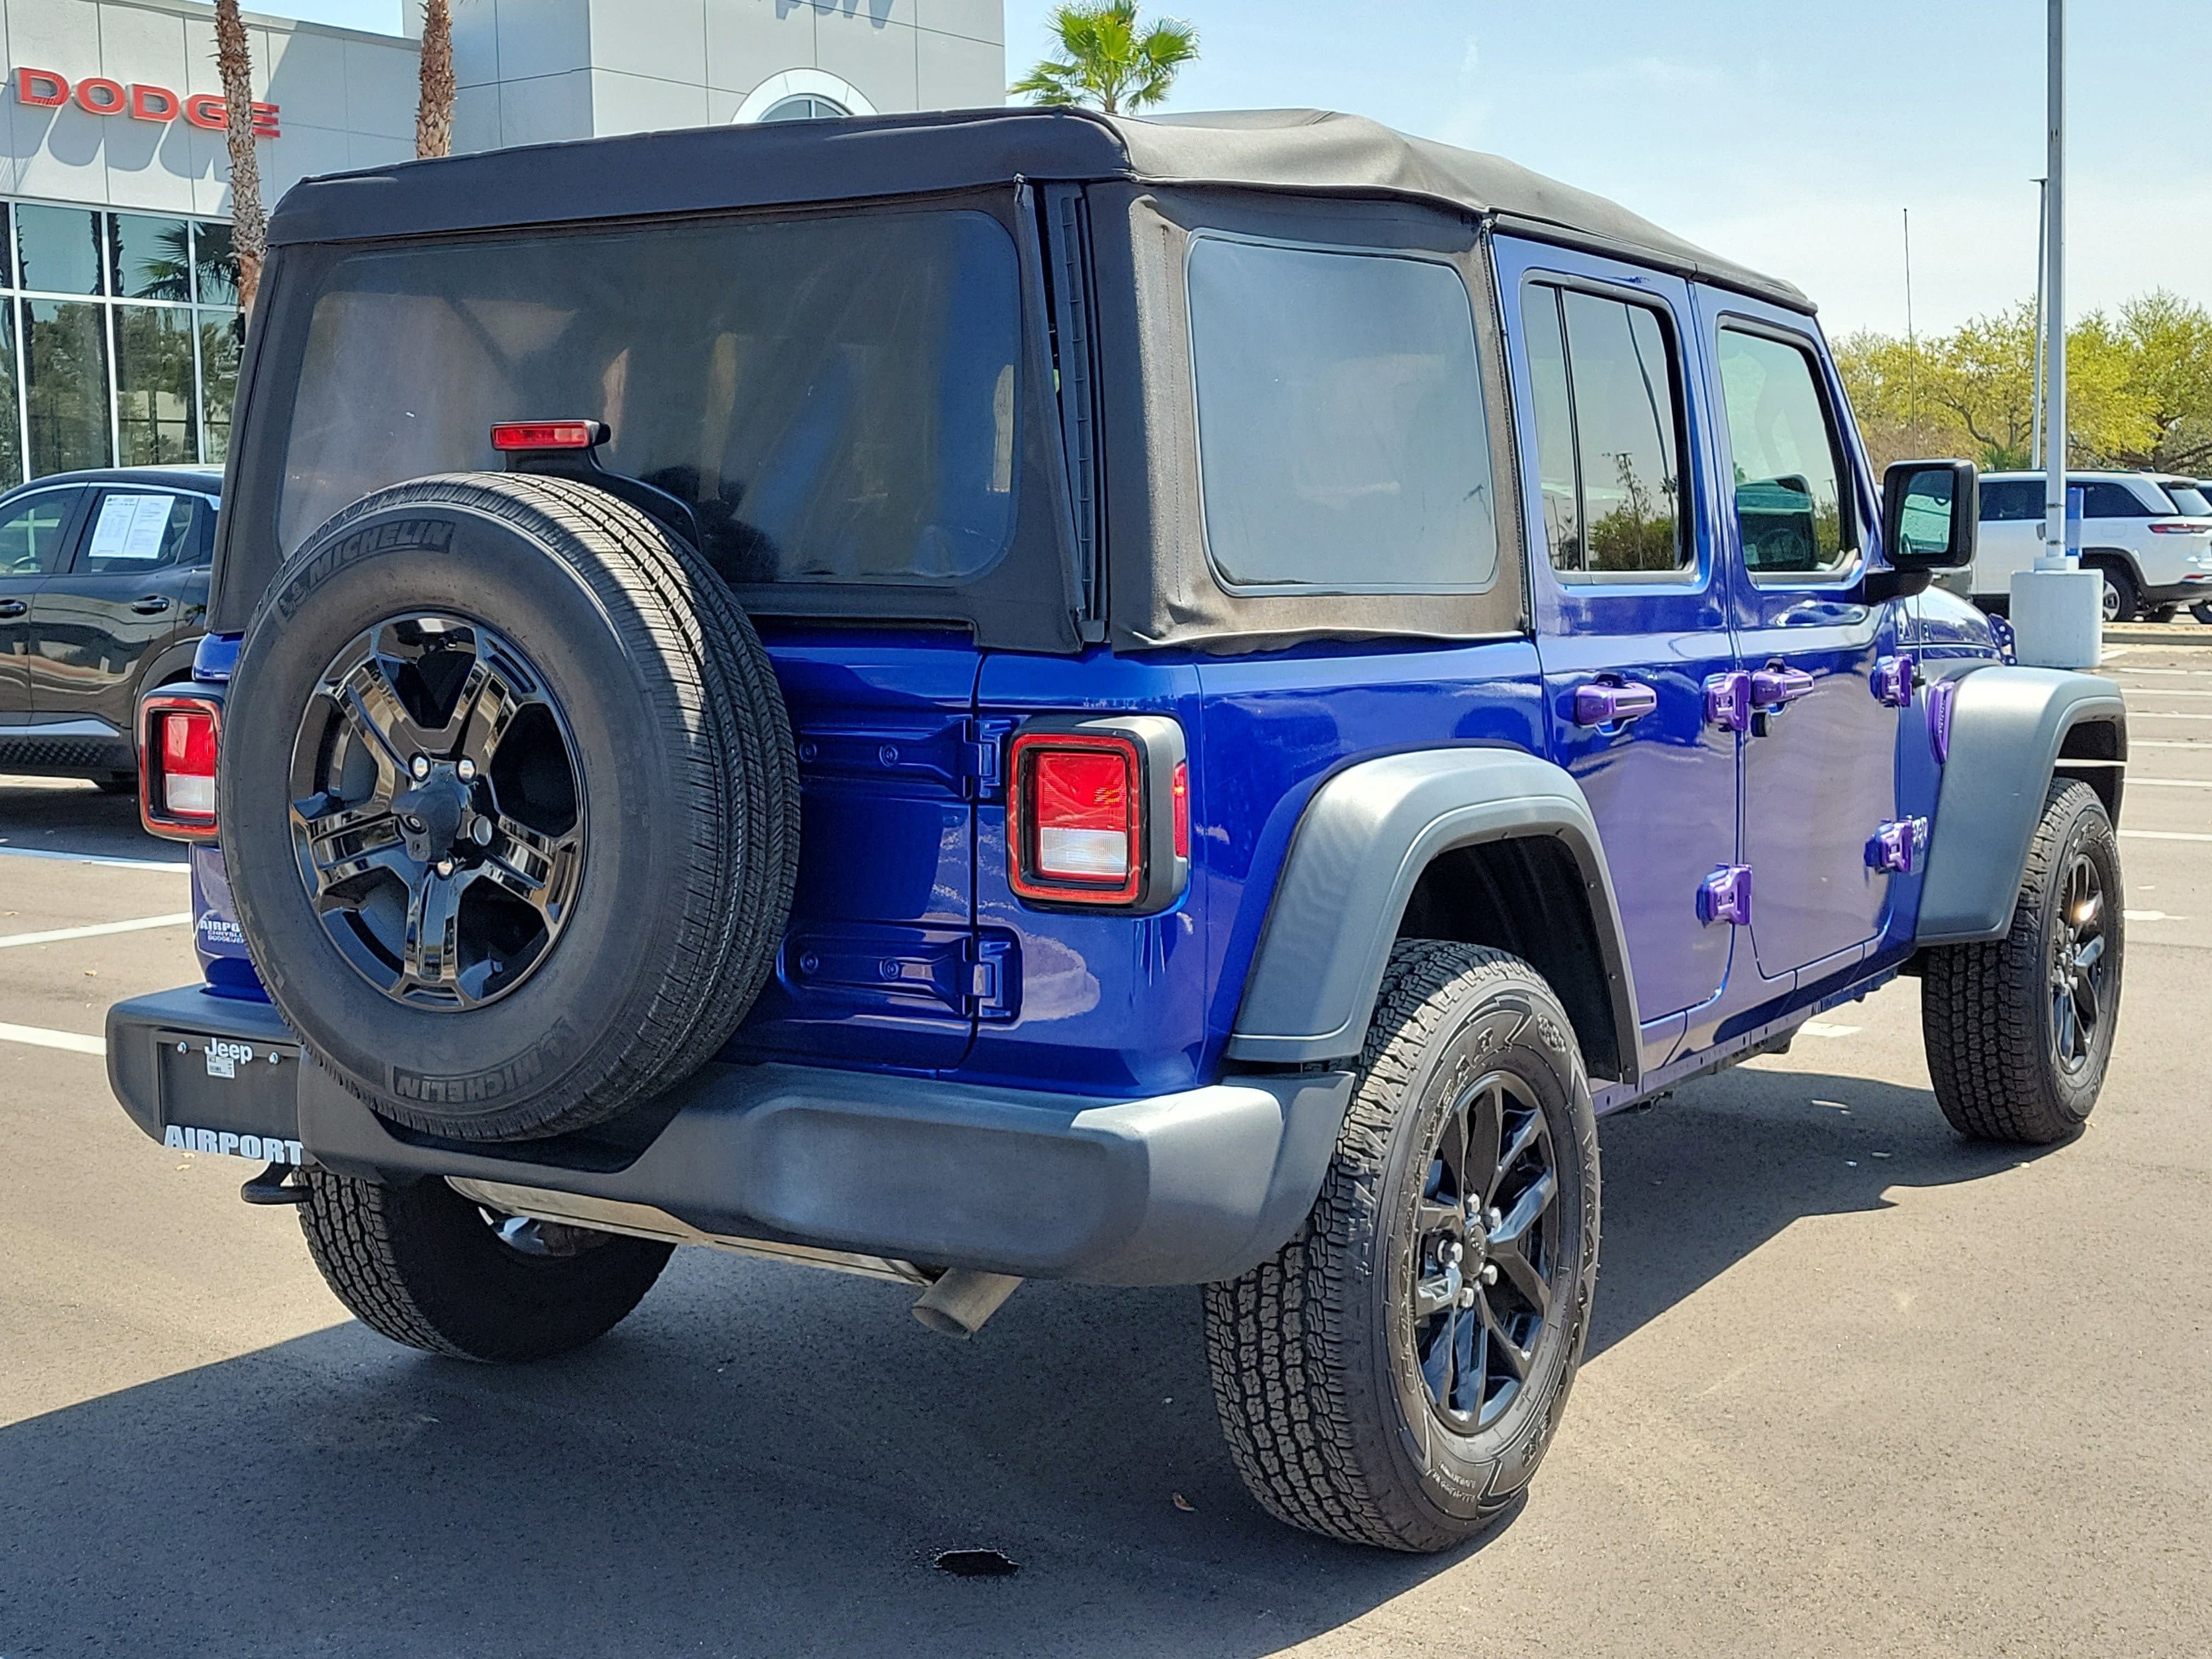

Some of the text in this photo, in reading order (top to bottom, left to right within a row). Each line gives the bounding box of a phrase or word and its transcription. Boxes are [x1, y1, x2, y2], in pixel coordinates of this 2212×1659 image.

[13, 66, 280, 138] DODGE
[309, 521, 455, 584] MICHELIN
[204, 1037, 253, 1064] Jeep
[164, 1125, 303, 1166] AIRPORT
